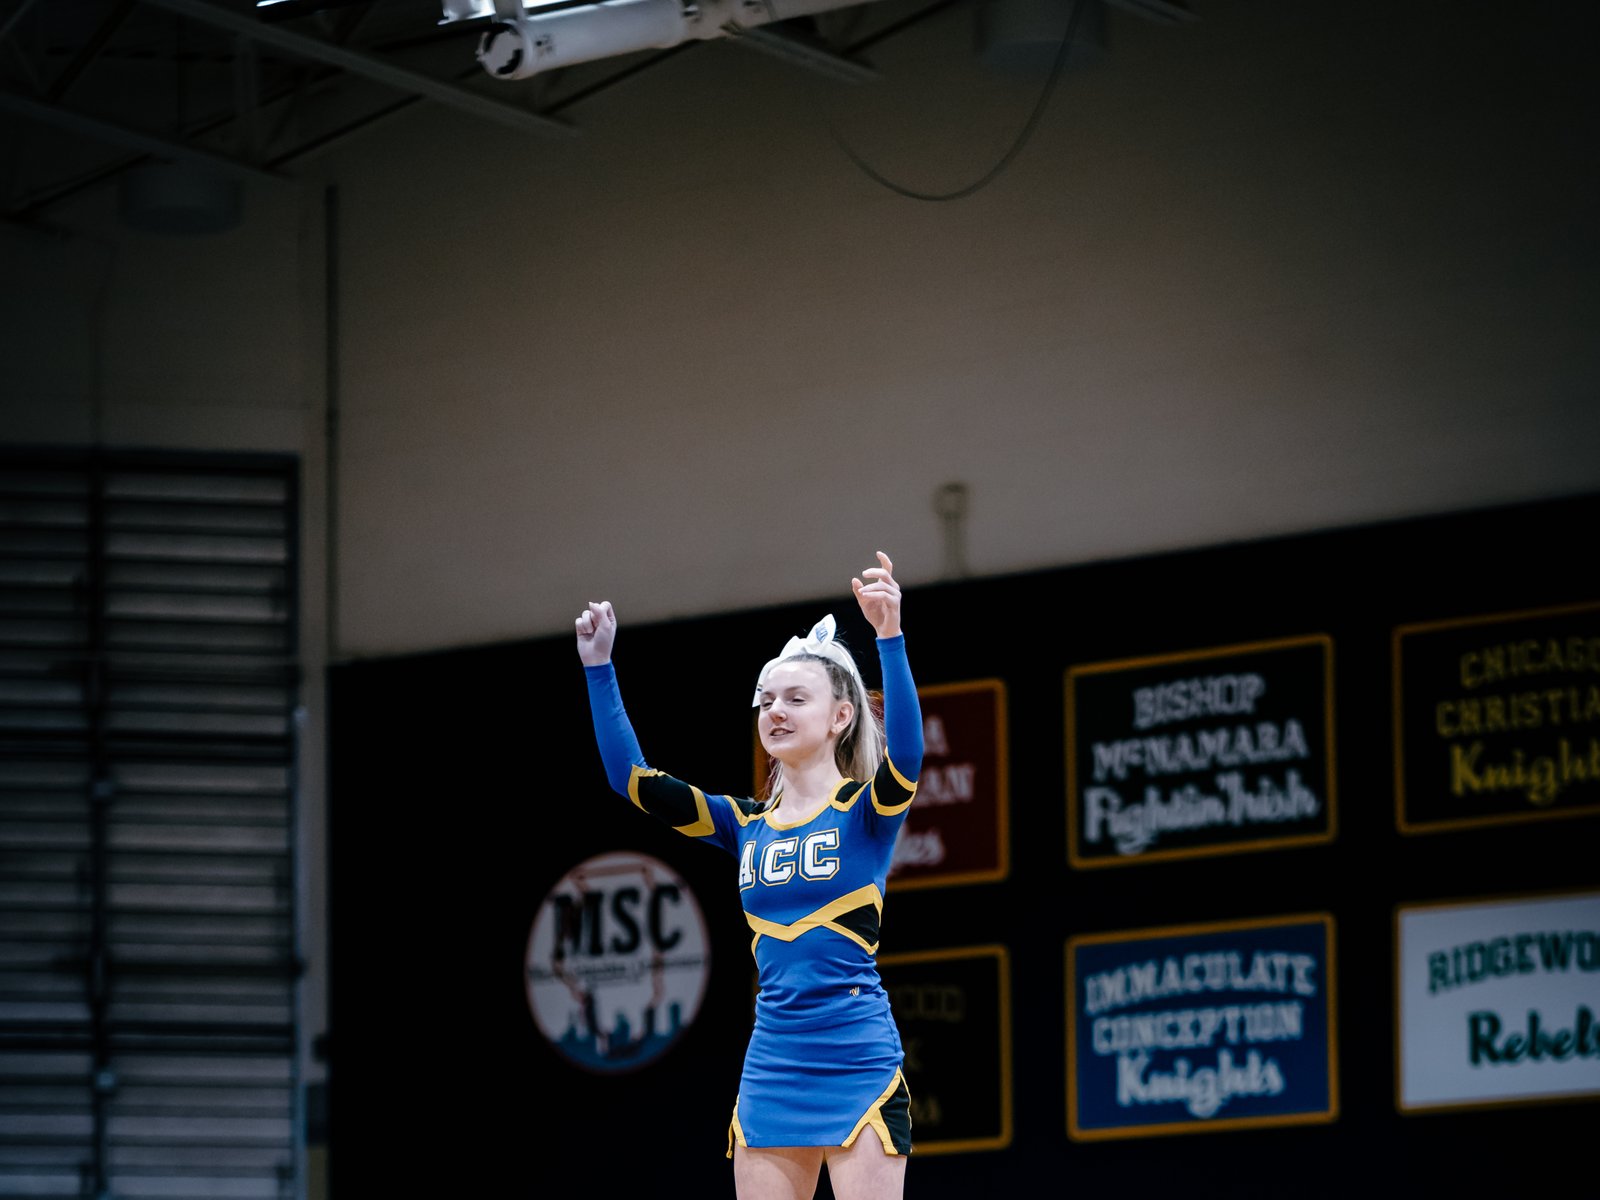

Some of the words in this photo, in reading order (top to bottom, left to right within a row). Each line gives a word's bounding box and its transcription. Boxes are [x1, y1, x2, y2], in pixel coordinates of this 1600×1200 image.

[1132, 673, 1265, 731] BISHOP
[738, 827, 841, 893] ACC
[554, 883, 682, 961] MSC
[1086, 950, 1317, 1015] IMMACULATE
[1092, 1000, 1303, 1056] CONCEPTION
[1116, 1047, 1285, 1119] Knights
